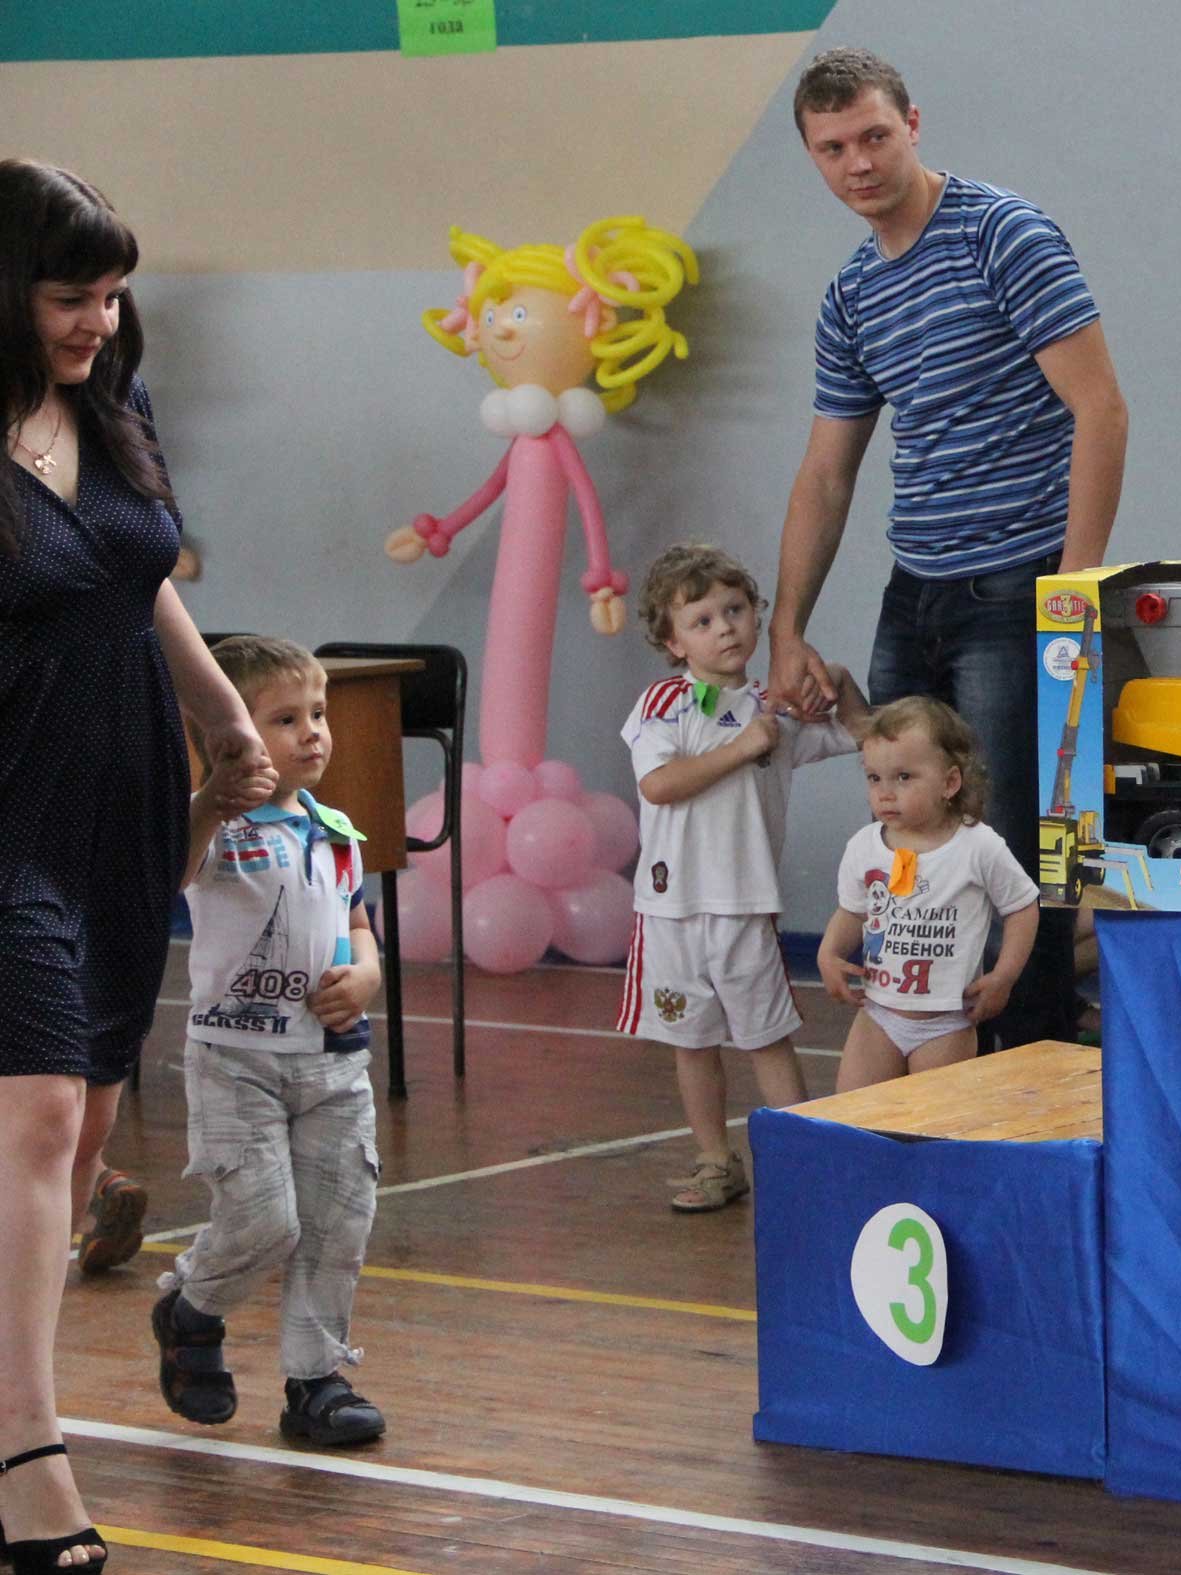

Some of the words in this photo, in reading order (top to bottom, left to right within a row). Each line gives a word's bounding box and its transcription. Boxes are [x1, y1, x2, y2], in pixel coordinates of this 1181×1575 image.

[891, 905, 958, 922] САМЫЙ
[887, 922, 956, 939] ЛУЧШИЙ
[884, 938, 955, 957] РЕБЁНОК
[231, 969, 309, 1001] 408
[888, 1217, 938, 1343] 3
